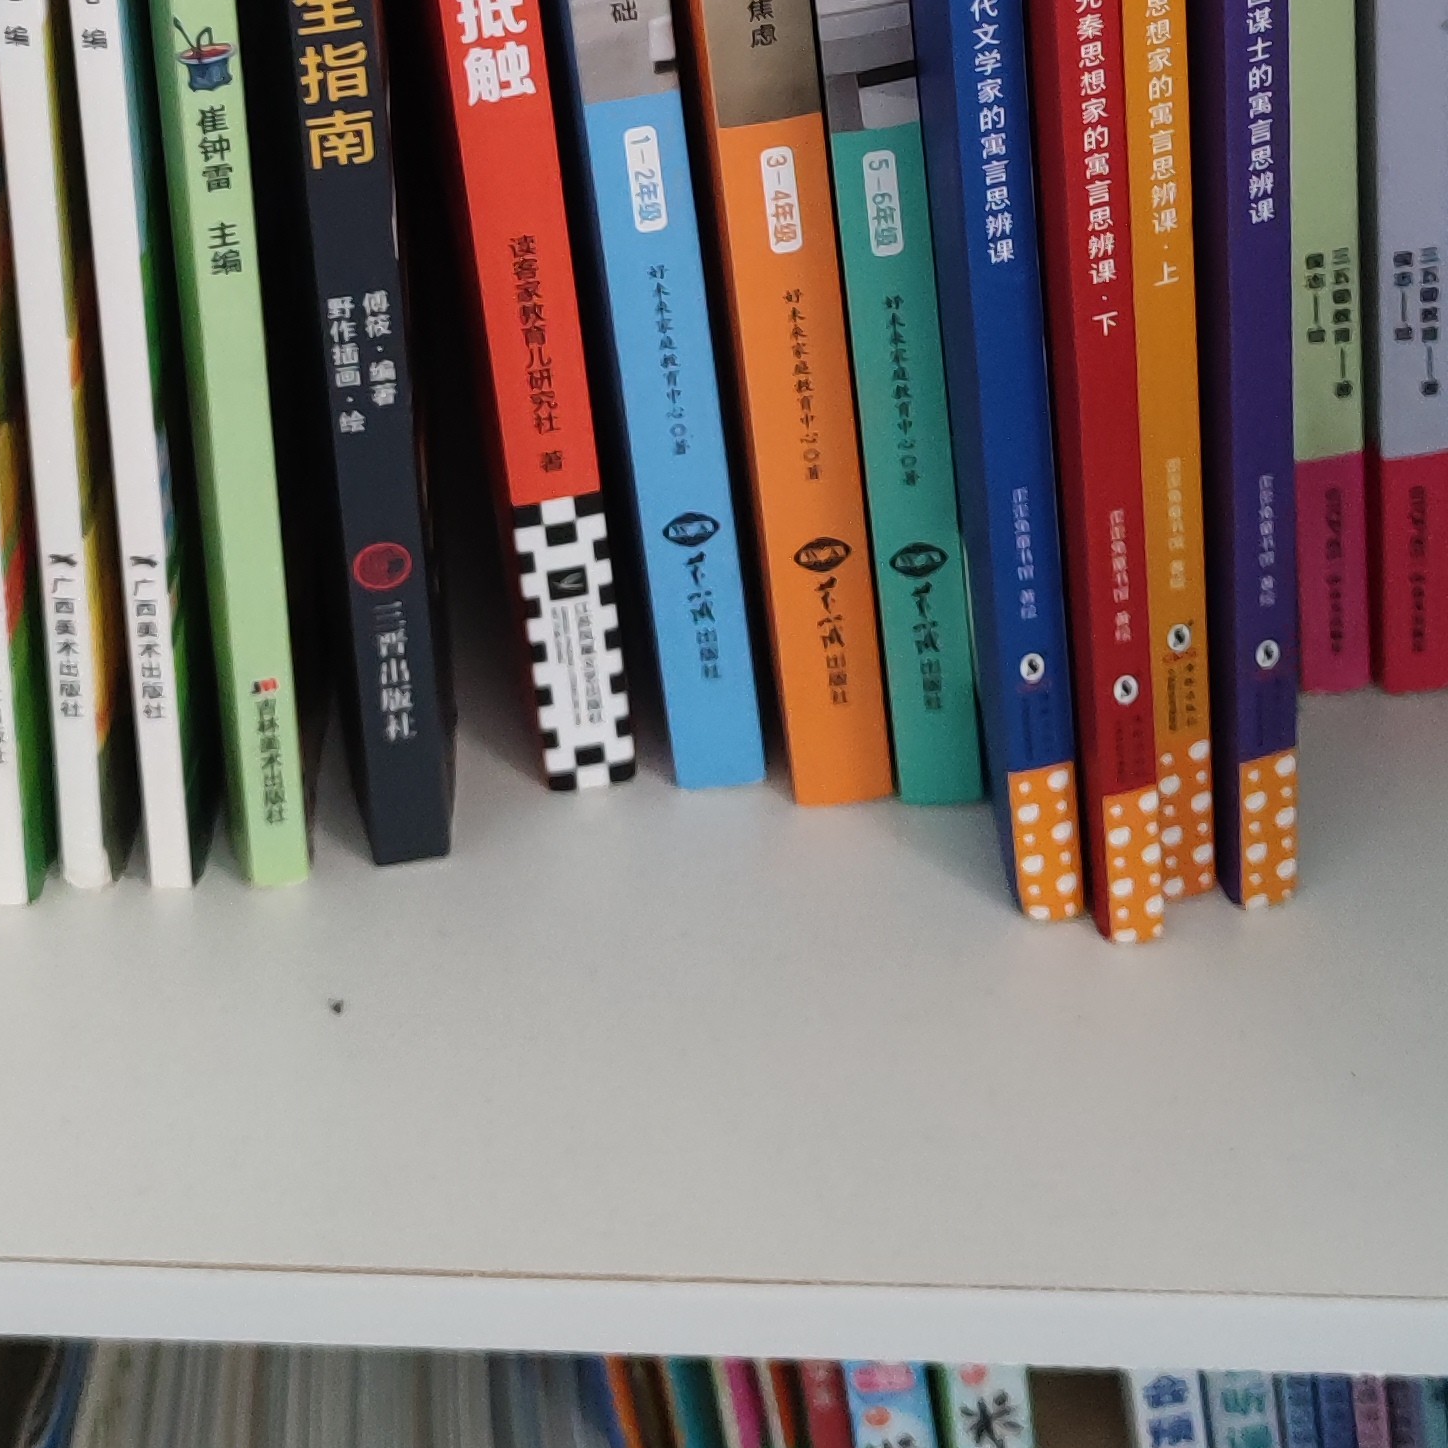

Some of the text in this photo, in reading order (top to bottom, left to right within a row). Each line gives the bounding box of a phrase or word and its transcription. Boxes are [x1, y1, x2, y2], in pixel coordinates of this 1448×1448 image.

[195, 103, 244, 277] 崔钟雷 主编
[51, 574, 85, 720] 广西美术出版社
[131, 577, 167, 721] 广西美术出版社
